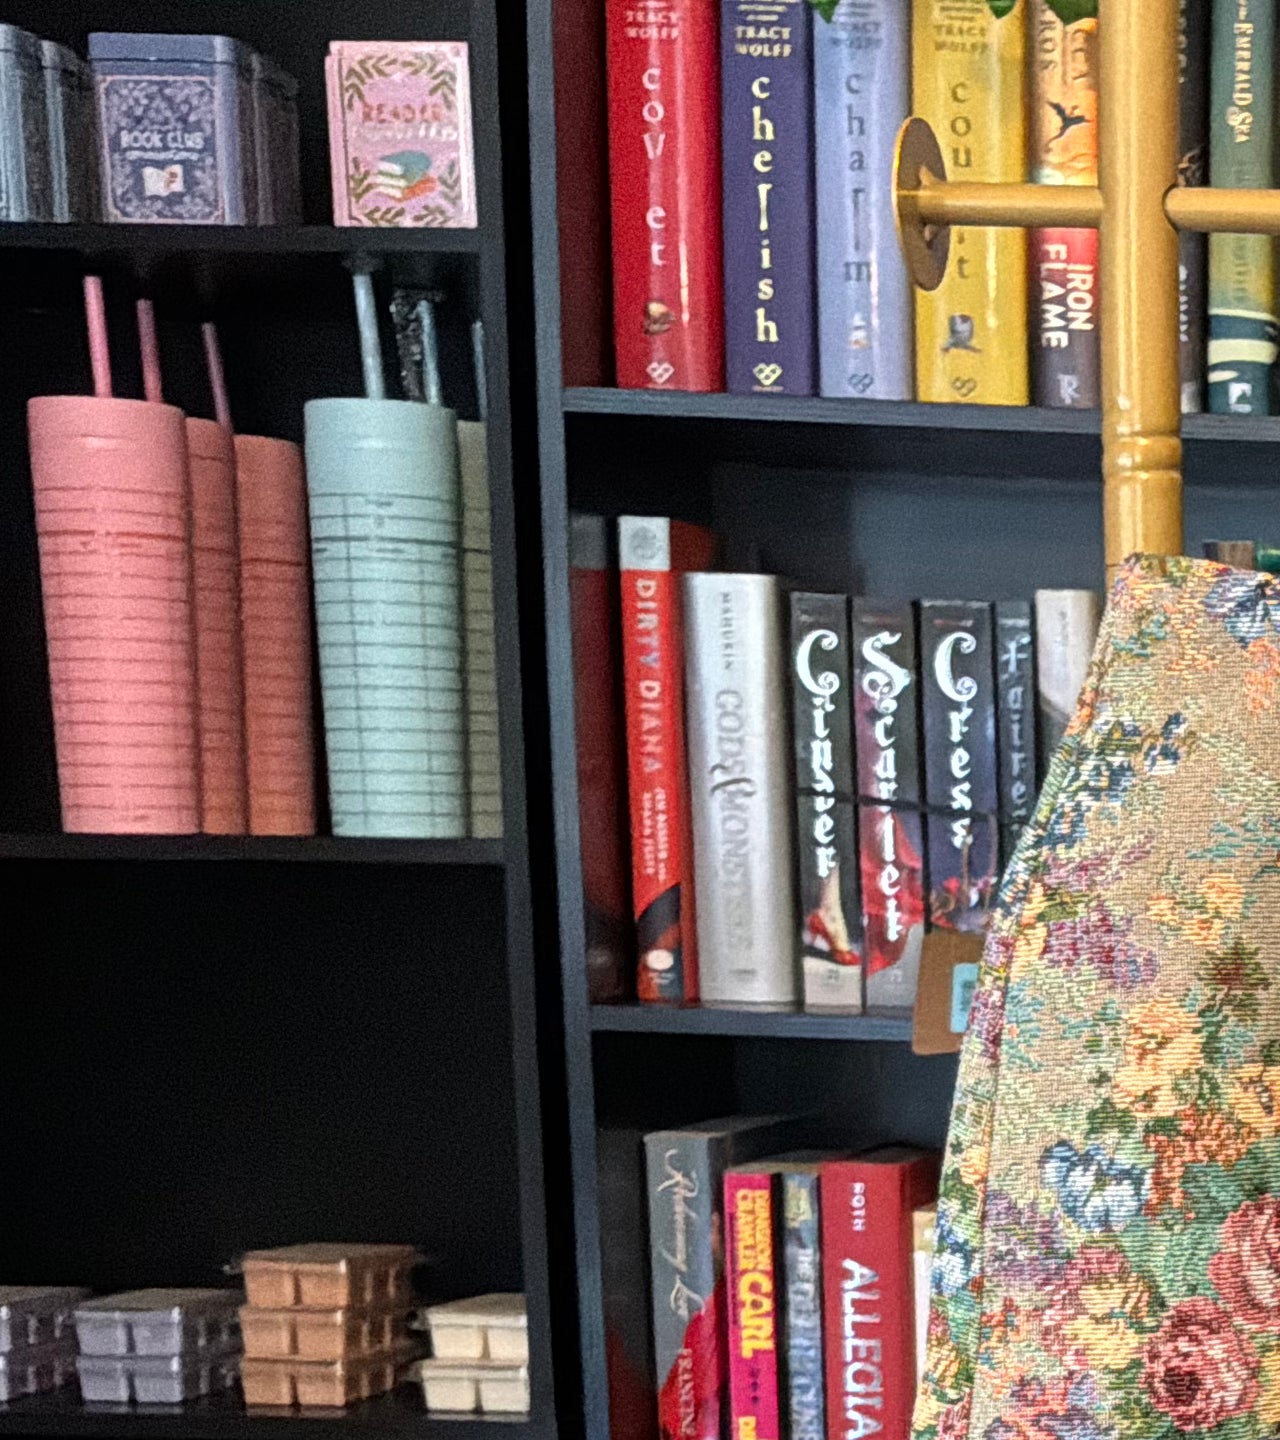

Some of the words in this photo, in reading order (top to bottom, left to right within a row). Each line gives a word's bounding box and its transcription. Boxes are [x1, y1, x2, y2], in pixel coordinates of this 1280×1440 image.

[734, 27, 792, 41] TRACY
[734, 43, 793, 57] WOLFF
[751, 76, 779, 343] cherish
[1040, 244, 1069, 349] FLAME
[1067, 263, 1094, 333] IRON
[635, 579, 660, 668] DIRTY
[639, 680, 663, 774] DIANA
[797, 630, 840, 878] Cinder
[934, 631, 977, 849] Cress
[861, 631, 911, 942] Scarlet
[851, 1181, 865, 1231] ROTH
[739, 1273, 774, 1359] CARL
